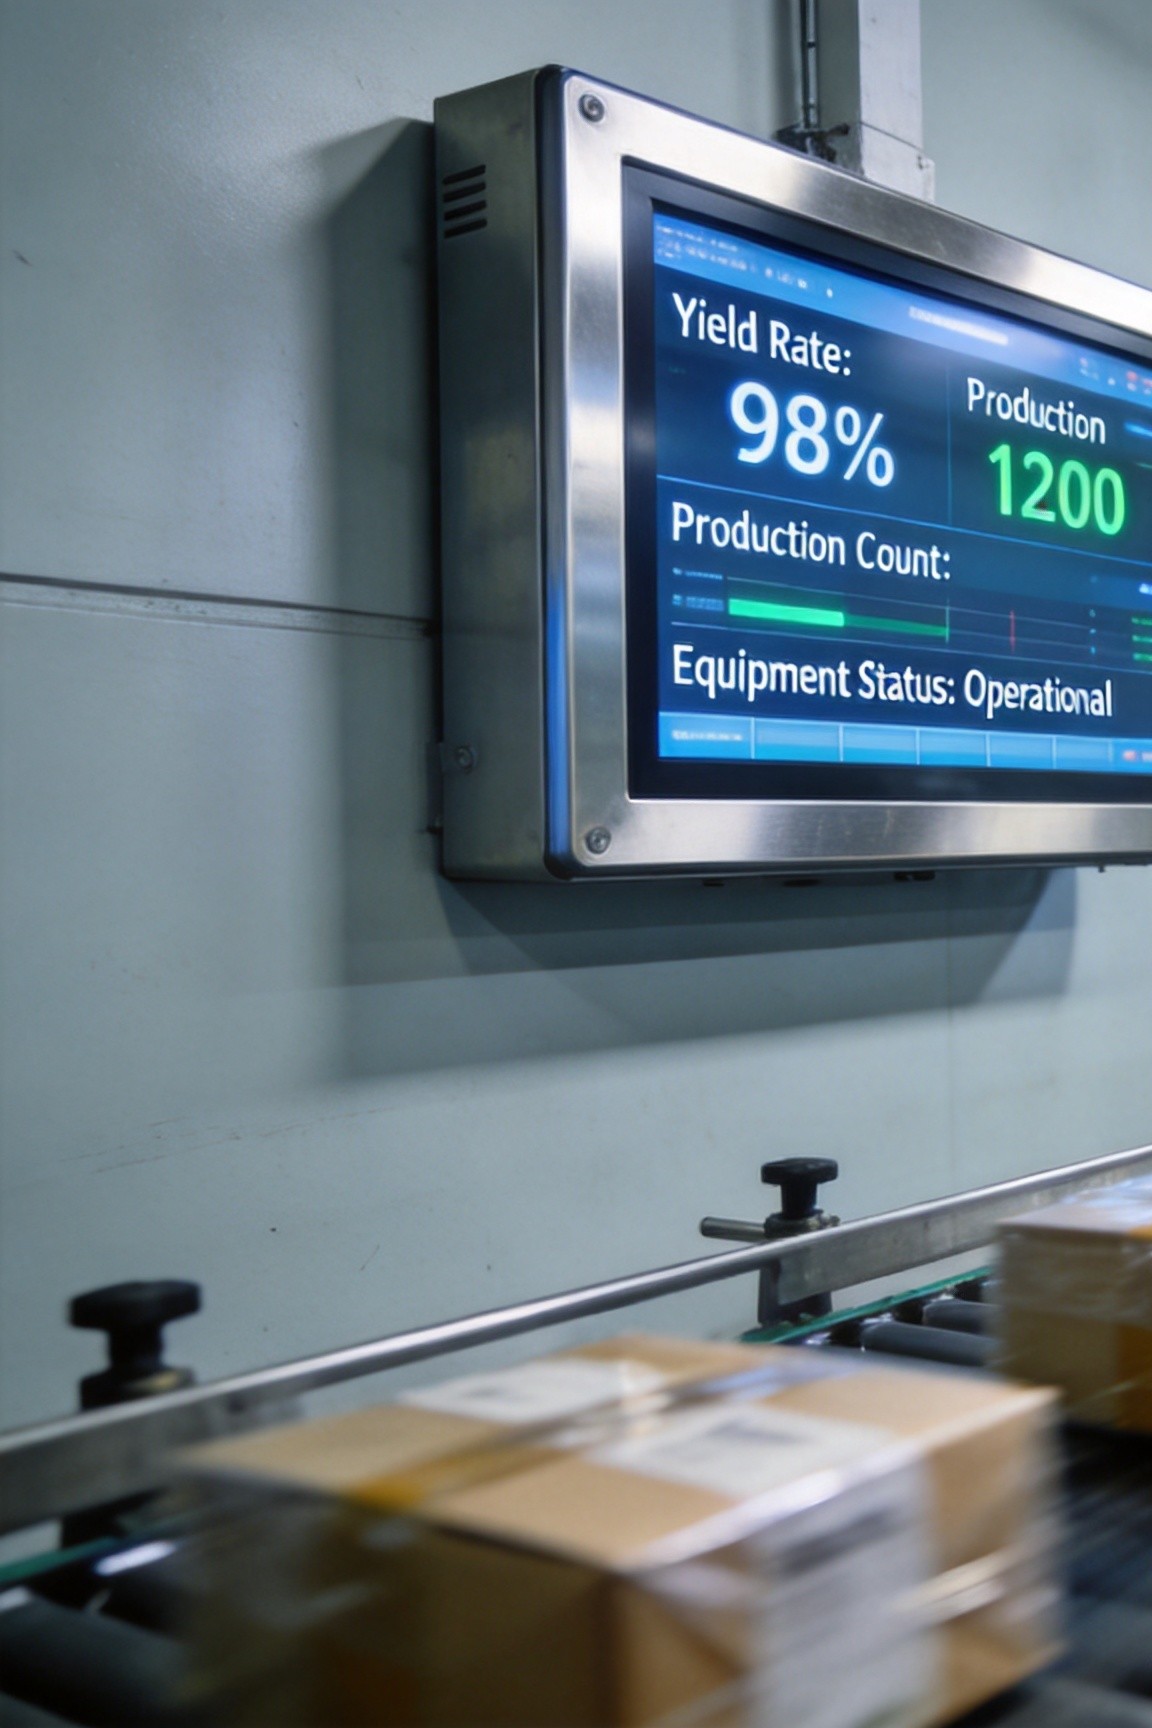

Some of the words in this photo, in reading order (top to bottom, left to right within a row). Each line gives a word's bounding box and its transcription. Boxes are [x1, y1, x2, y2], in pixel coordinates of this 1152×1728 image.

[672, 293, 758, 353] Yield
[770, 319, 851, 376] Rate:
[731, 382, 894, 487] 98%
[967, 377, 1106, 444] Production
[988, 444, 1125, 535] 1200
[671, 502, 846, 566] Production
[856, 532, 951, 579] Count:
[672, 644, 851, 702] Equipment
[858, 660, 955, 705] Status:
[964, 669, 1112, 719] Operational
